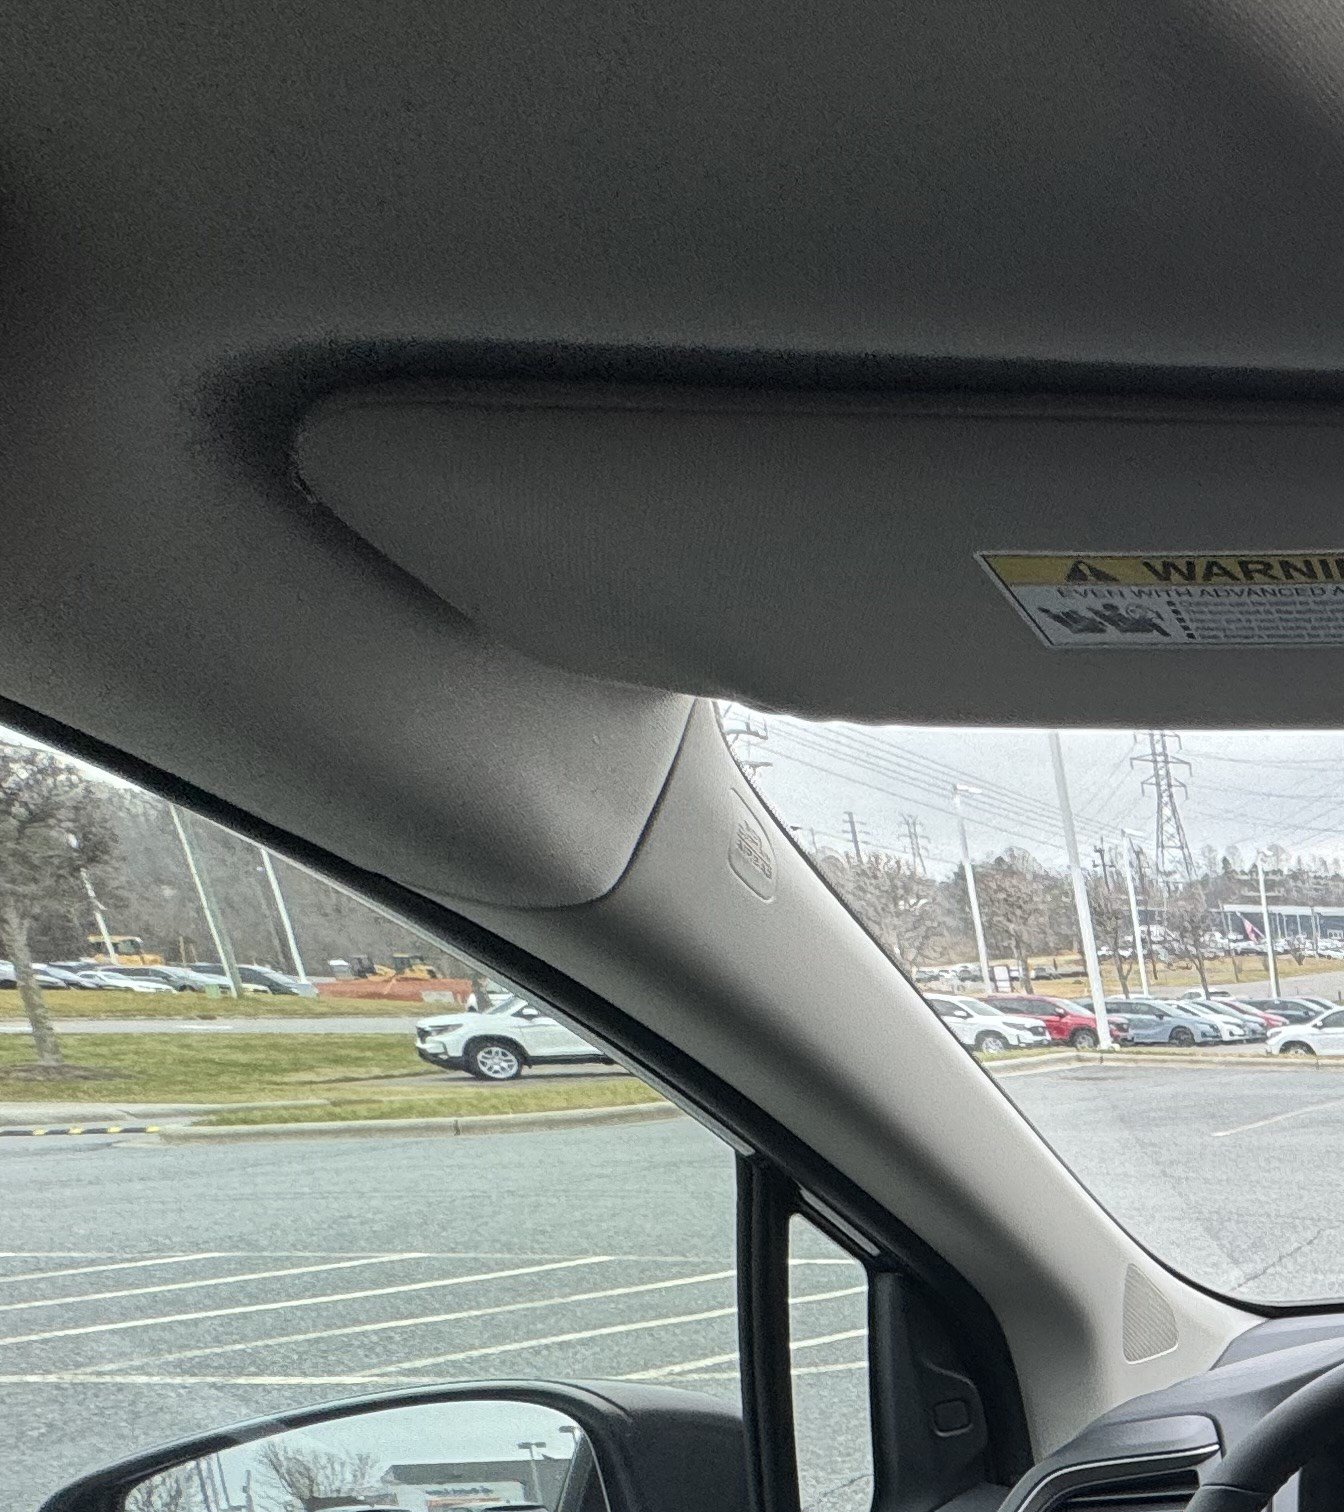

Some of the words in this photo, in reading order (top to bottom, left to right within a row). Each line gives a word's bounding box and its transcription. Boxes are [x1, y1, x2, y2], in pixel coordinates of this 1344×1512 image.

[1056, 587, 1124, 599] EVEN
[1130, 586, 1193, 598] WITH
[1200, 584, 1326, 598] ADVANCED
